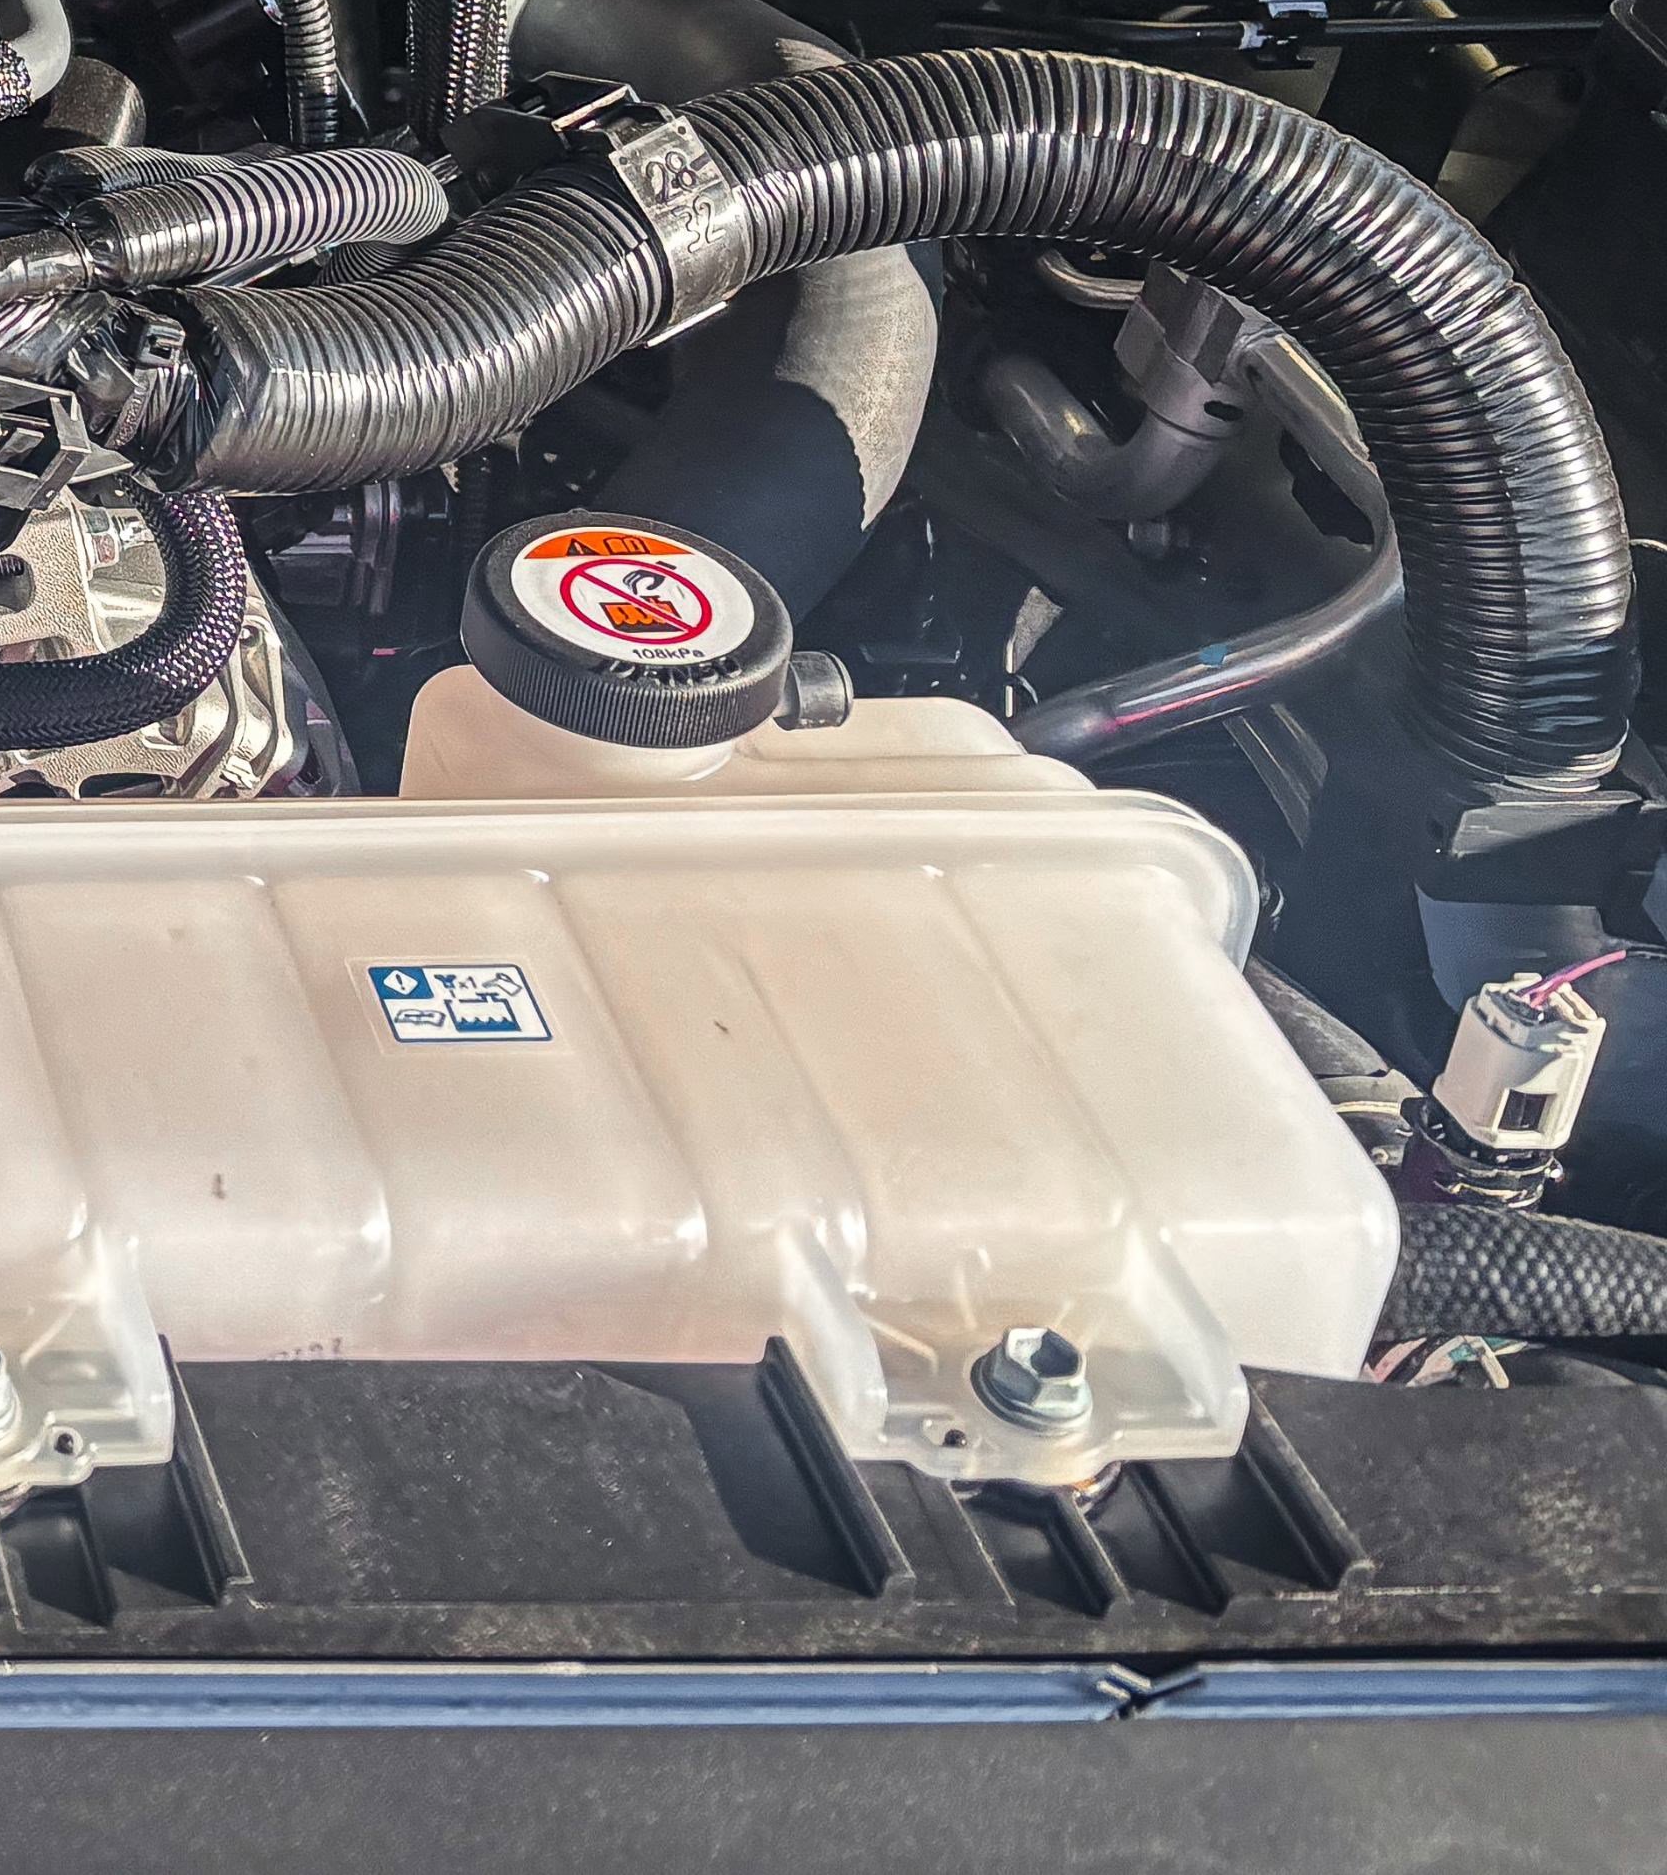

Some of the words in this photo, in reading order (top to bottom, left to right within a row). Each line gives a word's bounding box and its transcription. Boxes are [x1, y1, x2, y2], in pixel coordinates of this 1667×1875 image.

[644, 148, 701, 204] 28
[669, 196, 726, 255] 32
[631, 647, 705, 660] 108kPa
